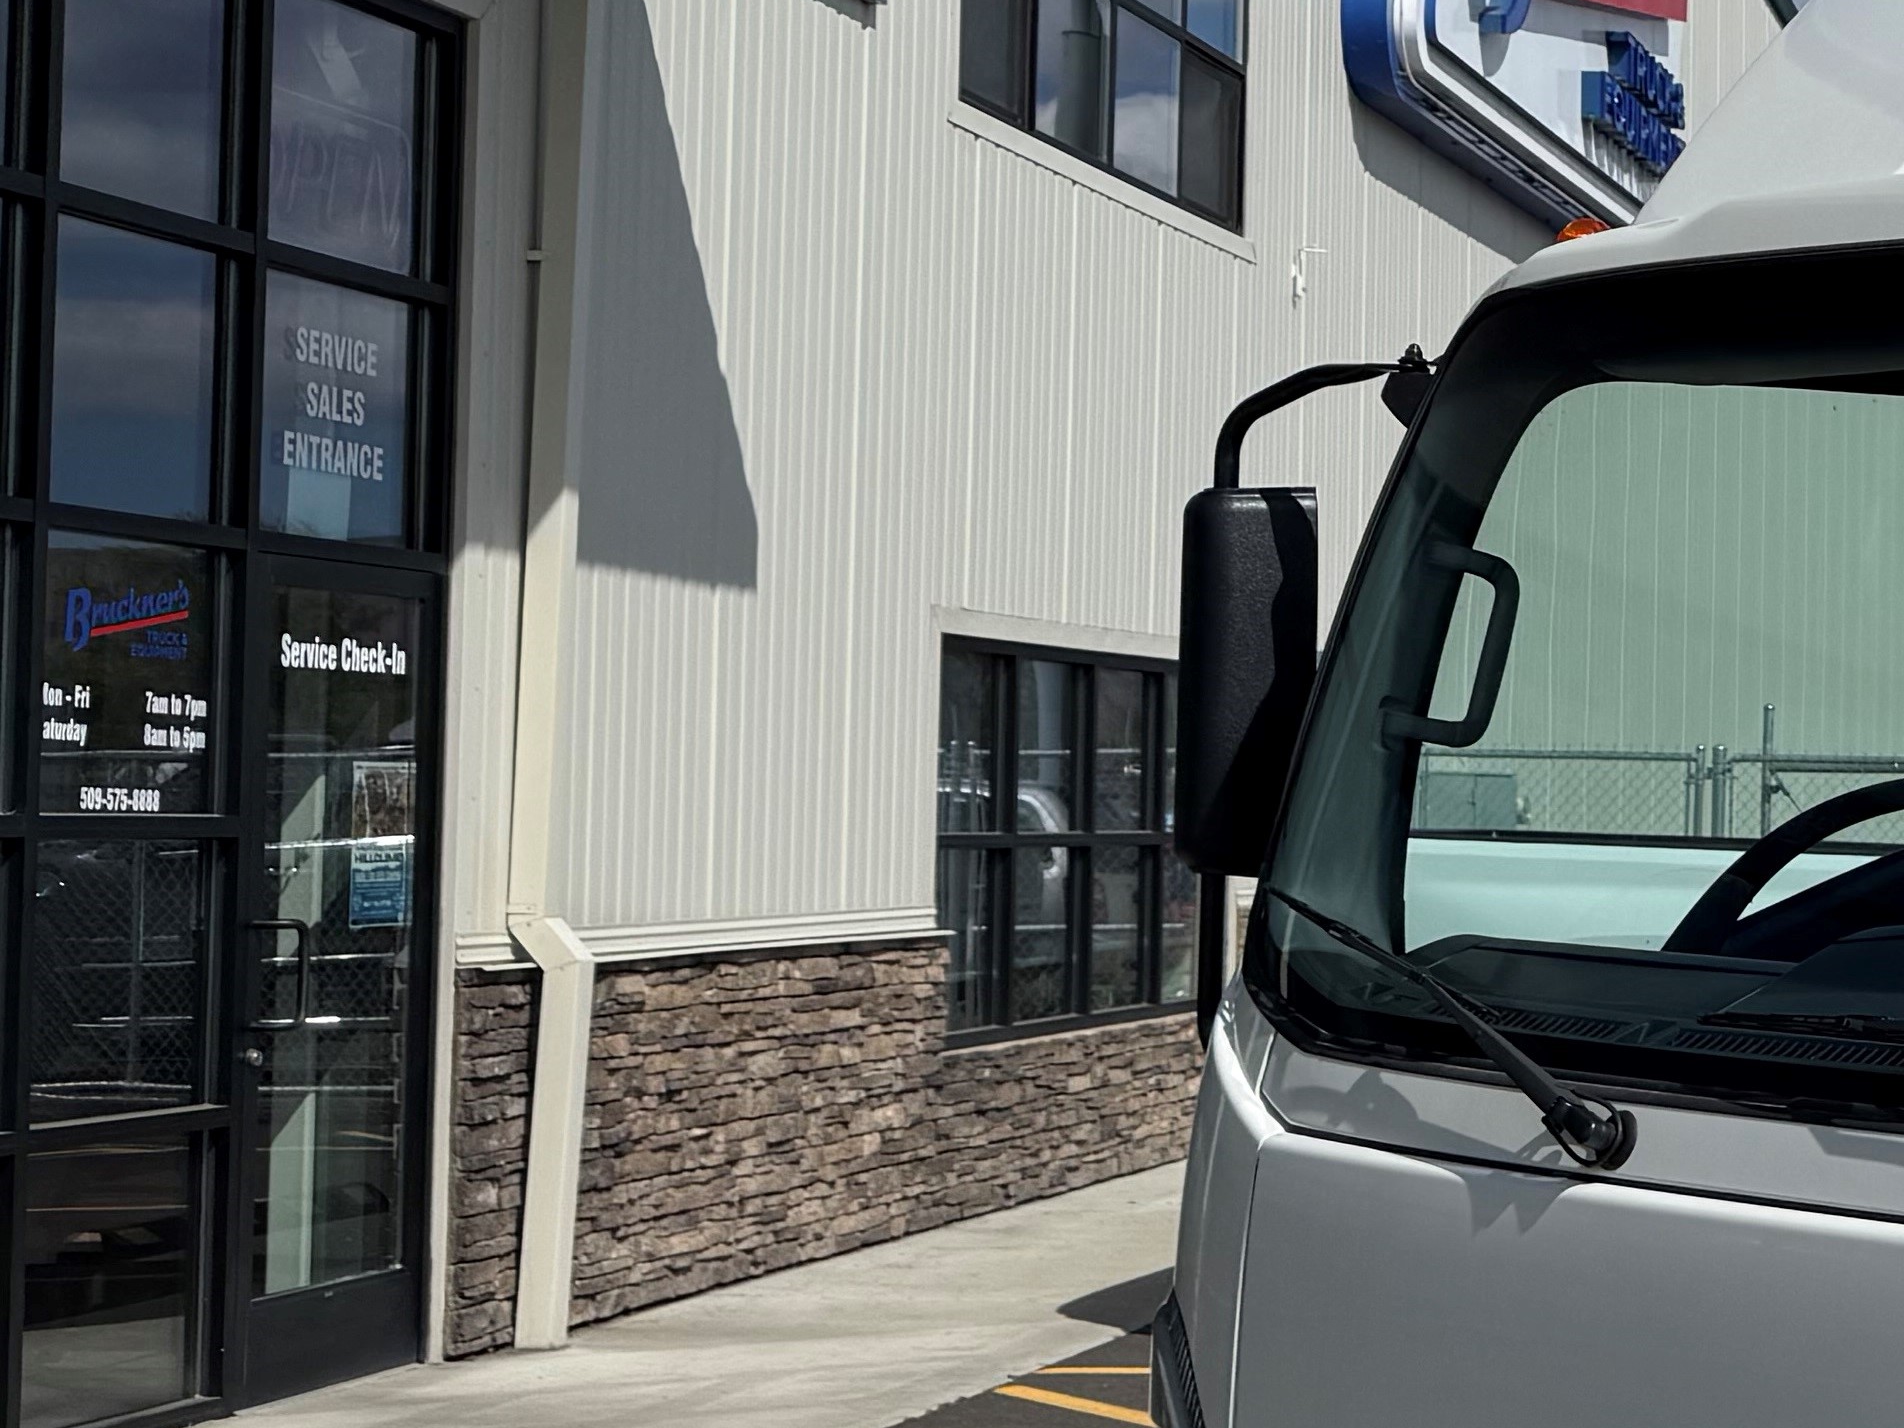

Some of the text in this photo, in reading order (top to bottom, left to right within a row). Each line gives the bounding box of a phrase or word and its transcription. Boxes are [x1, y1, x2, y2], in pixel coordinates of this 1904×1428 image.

[295, 326, 379, 377] SERVICE
[306, 381, 365, 426] SALES
[283, 430, 384, 481] ENTRANCE
[63, 579, 190, 652] Bruckner's
[280, 632, 406, 675] Service Check-In
[74, 684, 90, 709] Fri
[145, 691, 169, 714] 7am
[171, 693, 182, 716] to
[184, 693, 207, 721] 7pm
[169, 725, 181, 748] to
